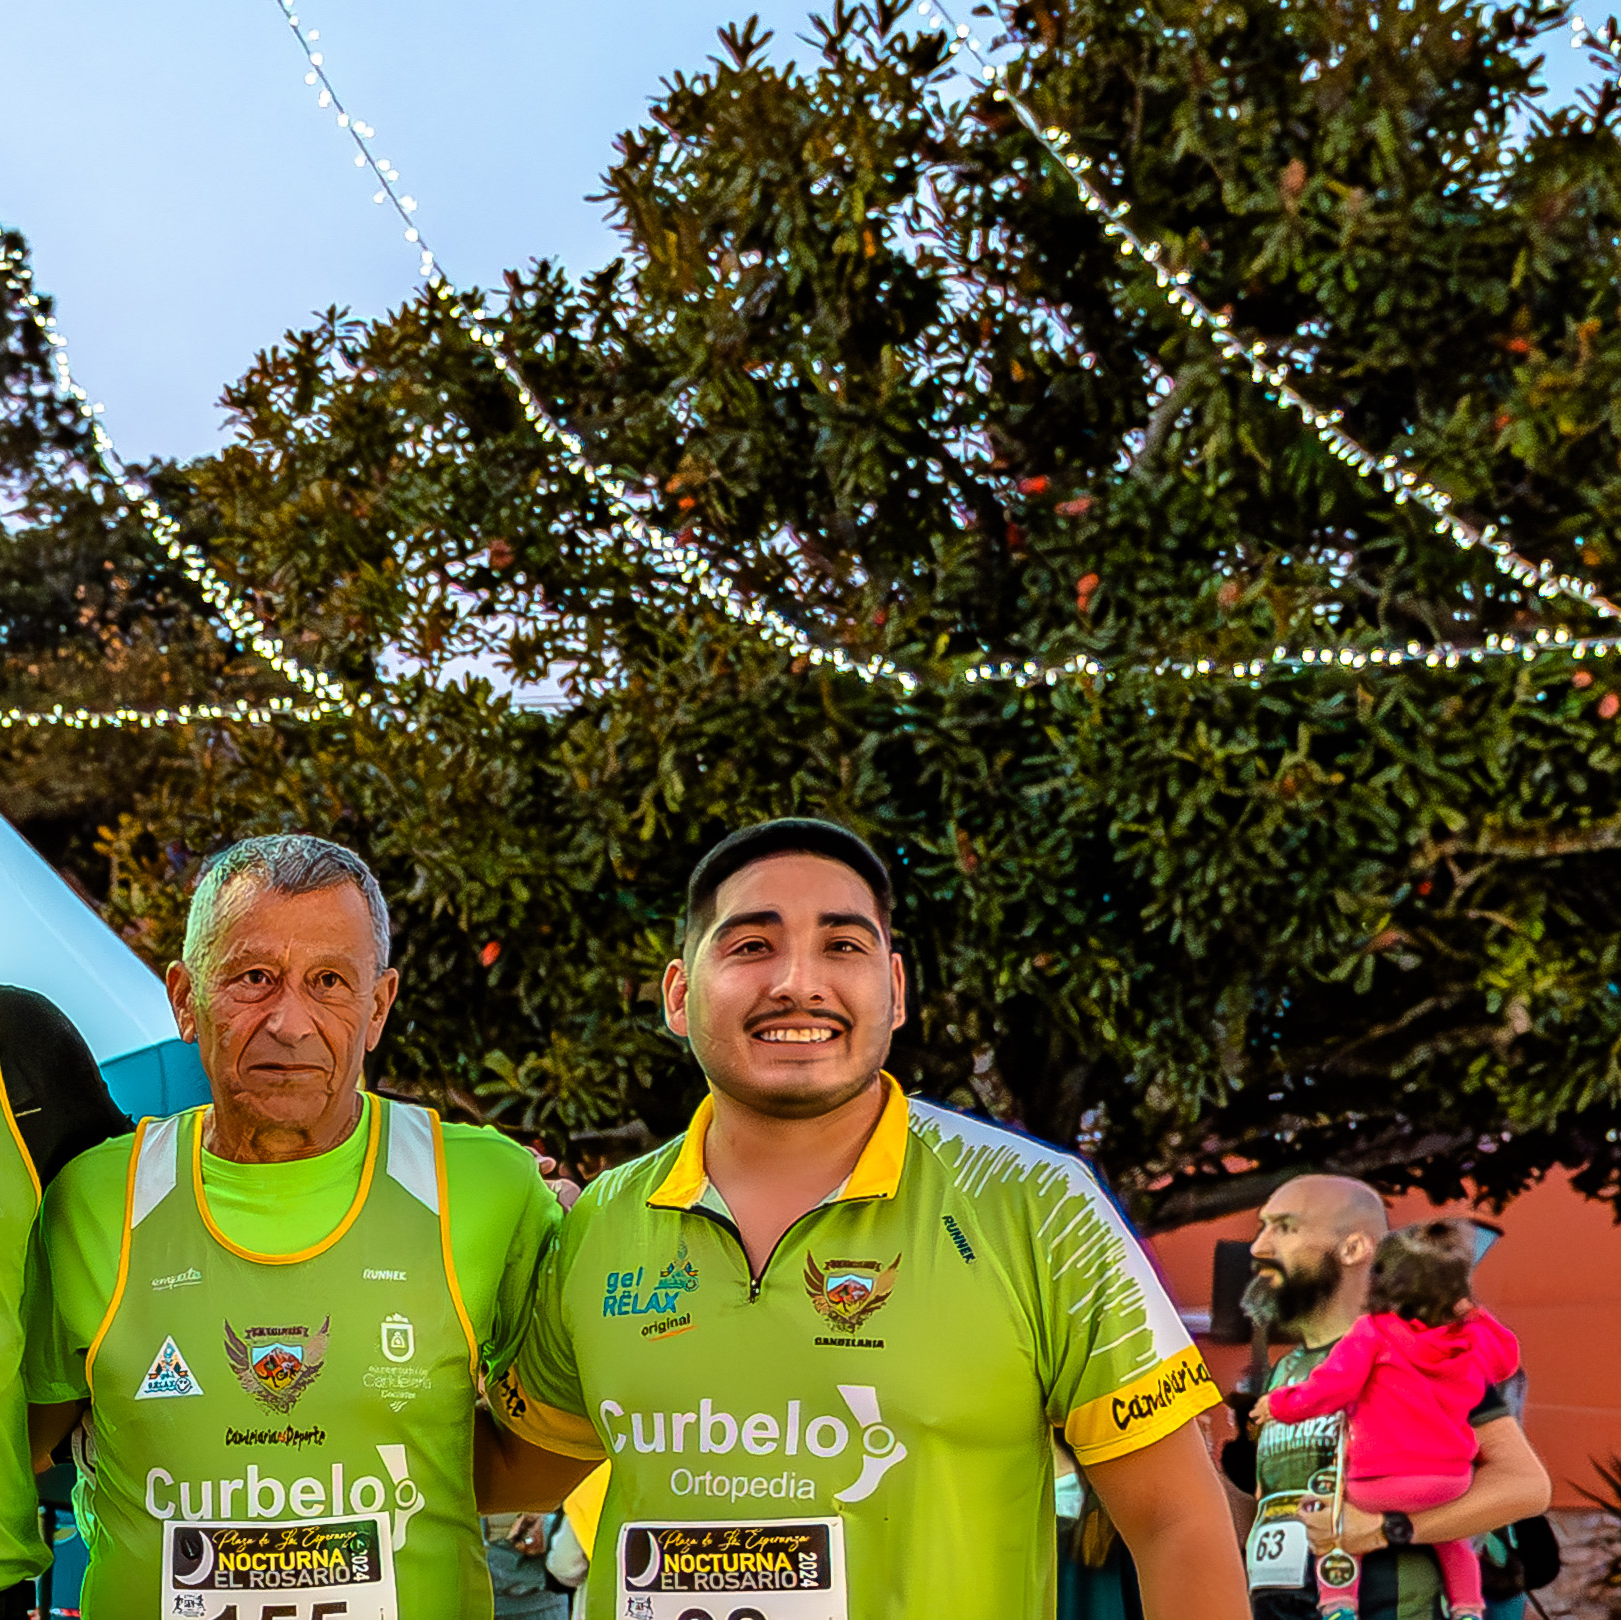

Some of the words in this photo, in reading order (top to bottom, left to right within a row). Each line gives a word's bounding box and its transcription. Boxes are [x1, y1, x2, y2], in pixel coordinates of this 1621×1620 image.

[942, 1215, 976, 1264] RUNNEK
[607, 1266, 643, 1294] gel
[641, 1313, 691, 1336] original
[599, 1398, 849, 1458] Curbelo
[145, 1463, 386, 1521] Curbelo
[671, 1468, 816, 1503] Ortopedia
[218, 1548, 345, 1571] NOCTURNA
[665, 1552, 792, 1573] NOCTURNA
[799, 1552, 818, 1588] 2024
[215, 1571, 243, 1588] EL
[250, 1565, 350, 1587] ROSARIO
[661, 1572, 688, 1590] EL
[695, 1570, 797, 1590] ROSARIO
